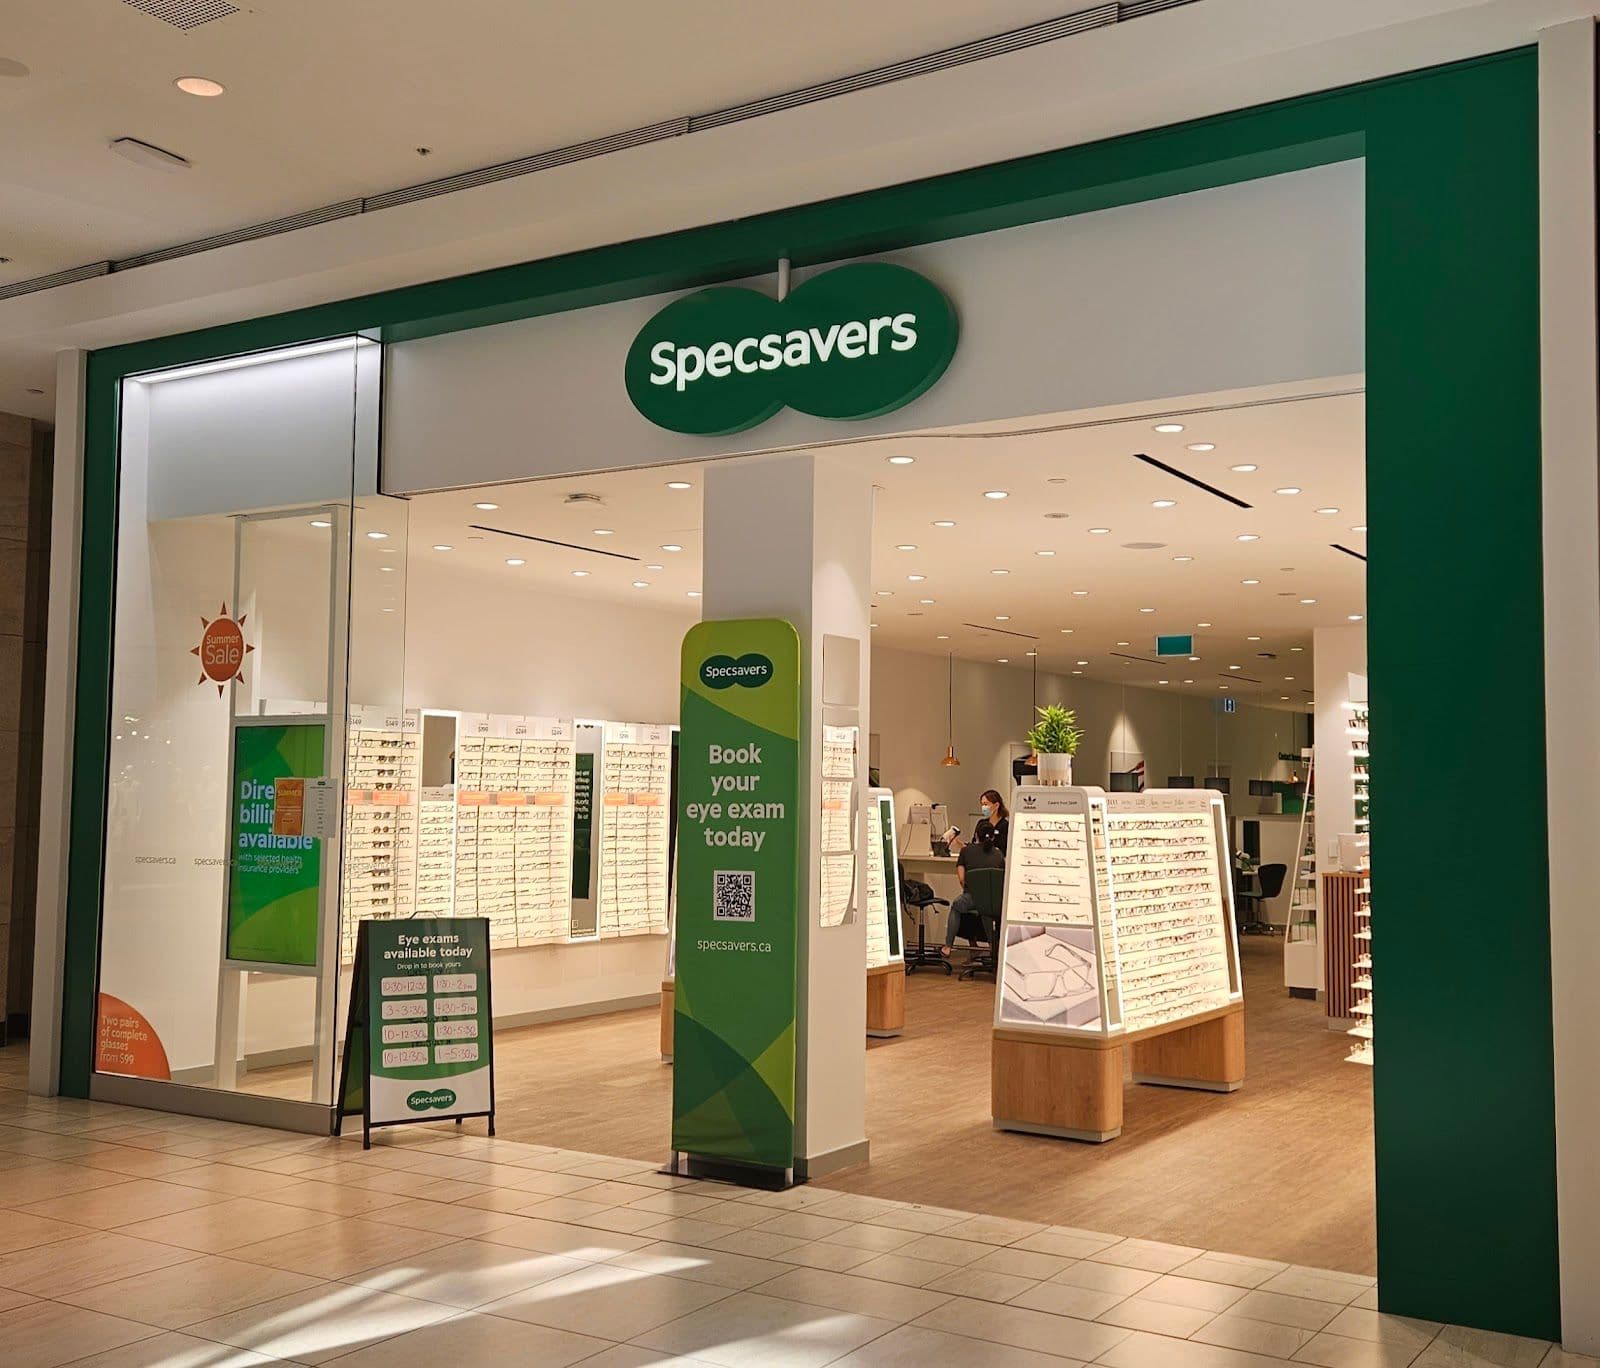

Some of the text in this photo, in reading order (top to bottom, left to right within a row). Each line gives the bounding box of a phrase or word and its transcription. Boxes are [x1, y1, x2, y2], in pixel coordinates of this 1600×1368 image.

[650, 313, 918, 391] Specsavers
[206, 635, 240, 645] Summer
[205, 645, 240, 665] Sale
[705, 664, 768, 679] Specsavers
[709, 743, 762, 765] Book
[241, 779, 274, 800] Dire
[710, 775, 760, 796] your
[240, 803, 274, 824] billi
[686, 803, 784, 824] eye exam
[239, 828, 313, 849] available
[704, 825, 766, 852] today
[134, 855, 177, 864] specsavers.ca
[398, 934, 460, 947] Eye exams
[697, 940, 772, 952] specsavers.ca
[383, 946, 473, 959] available today
[102, 1016, 140, 1029] Two pairs
[101, 1026, 147, 1041] of complete
[101, 1039, 128, 1051] glasses
[101, 1051, 134, 1065] from $99
[410, 1095, 453, 1105] Specsavers
